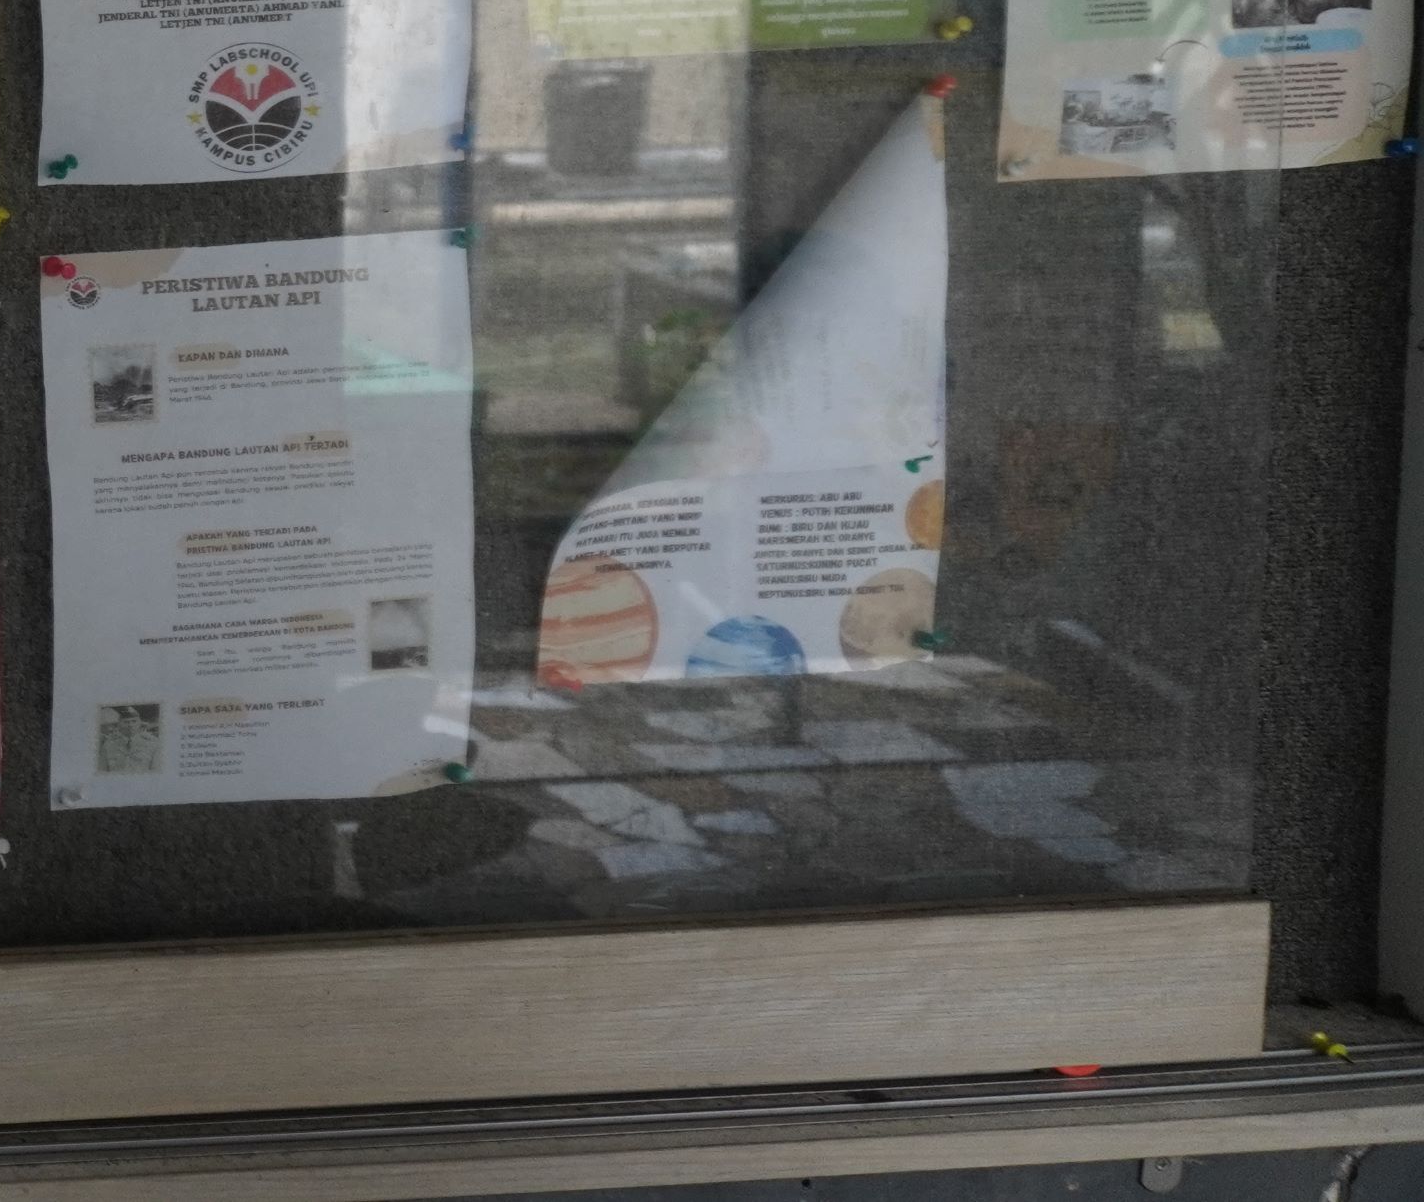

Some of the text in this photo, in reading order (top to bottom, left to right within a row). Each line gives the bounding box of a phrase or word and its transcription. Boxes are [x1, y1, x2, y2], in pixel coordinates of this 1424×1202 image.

[187, 47, 320, 105] SMP LABSCHOOL UPI
[194, 119, 315, 167] KAMPUS CIBIRU
[140, 267, 369, 298] PERISTIWA BANDUNG
[191, 290, 322, 314] LAUTAN API
[760, 509, 793, 518] VENUS
[244, 698, 326, 713] YANG TERLIBAT
